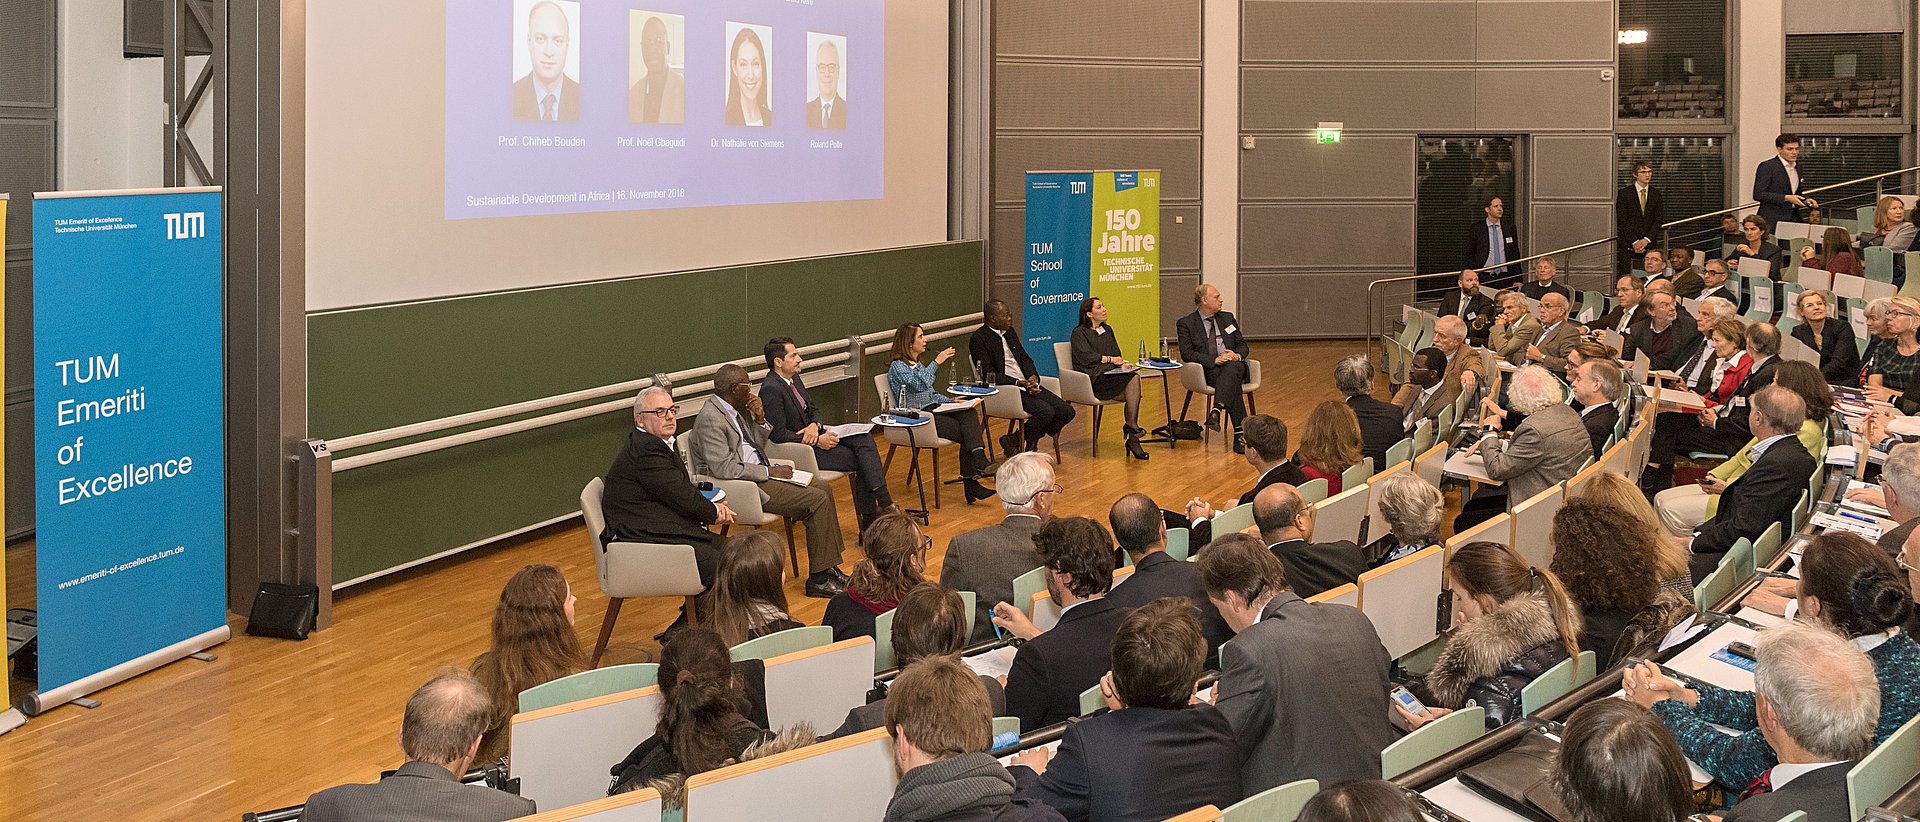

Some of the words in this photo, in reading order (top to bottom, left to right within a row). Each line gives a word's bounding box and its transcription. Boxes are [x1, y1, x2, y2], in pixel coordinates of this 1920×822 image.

[498, 135, 520, 147] Prof.
[522, 135, 553, 147] Chiheb
[554, 135, 586, 147] Bouden
[617, 136, 635, 147] Prof.
[711, 138, 720, 148] Dr.
[721, 138, 746, 148] Nathalie
[747, 140, 759, 148] von
[760, 138, 785, 148] Siemens
[810, 139, 829, 149] Roland
[1070, 182, 1086, 194] TUM
[1143, 178, 1155, 187] TUM
[466, 194, 520, 207] Sustainable
[522, 192, 577, 205] Development
[578, 191, 587, 202] in
[587, 190, 610, 201] Africa
[617, 189, 628, 200] 16.
[629, 188, 666, 199] November
[667, 188, 685, 198] 2018
[1105, 208, 1141, 231] 150
[164, 212, 205, 240] TUM
[1031, 242, 1053, 254] TUM
[1097, 230, 1155, 254] Jahre
[1030, 259, 1063, 272] School
[1103, 256, 1145, 266] TECHNISCHE
[1109, 262, 1153, 274] UNIVERSITÄT
[1030, 277, 1040, 288] of
[1099, 272, 1134, 282] MÜNCHEN
[1029, 292, 1084, 305] Governance
[55, 353, 119, 386] TUM
[57, 386, 145, 427] Emeriti
[57, 436, 84, 465] of
[58, 455, 193, 505] Excellence
[58, 545, 185, 590] www.emeriti-of-excellence.tum.de
